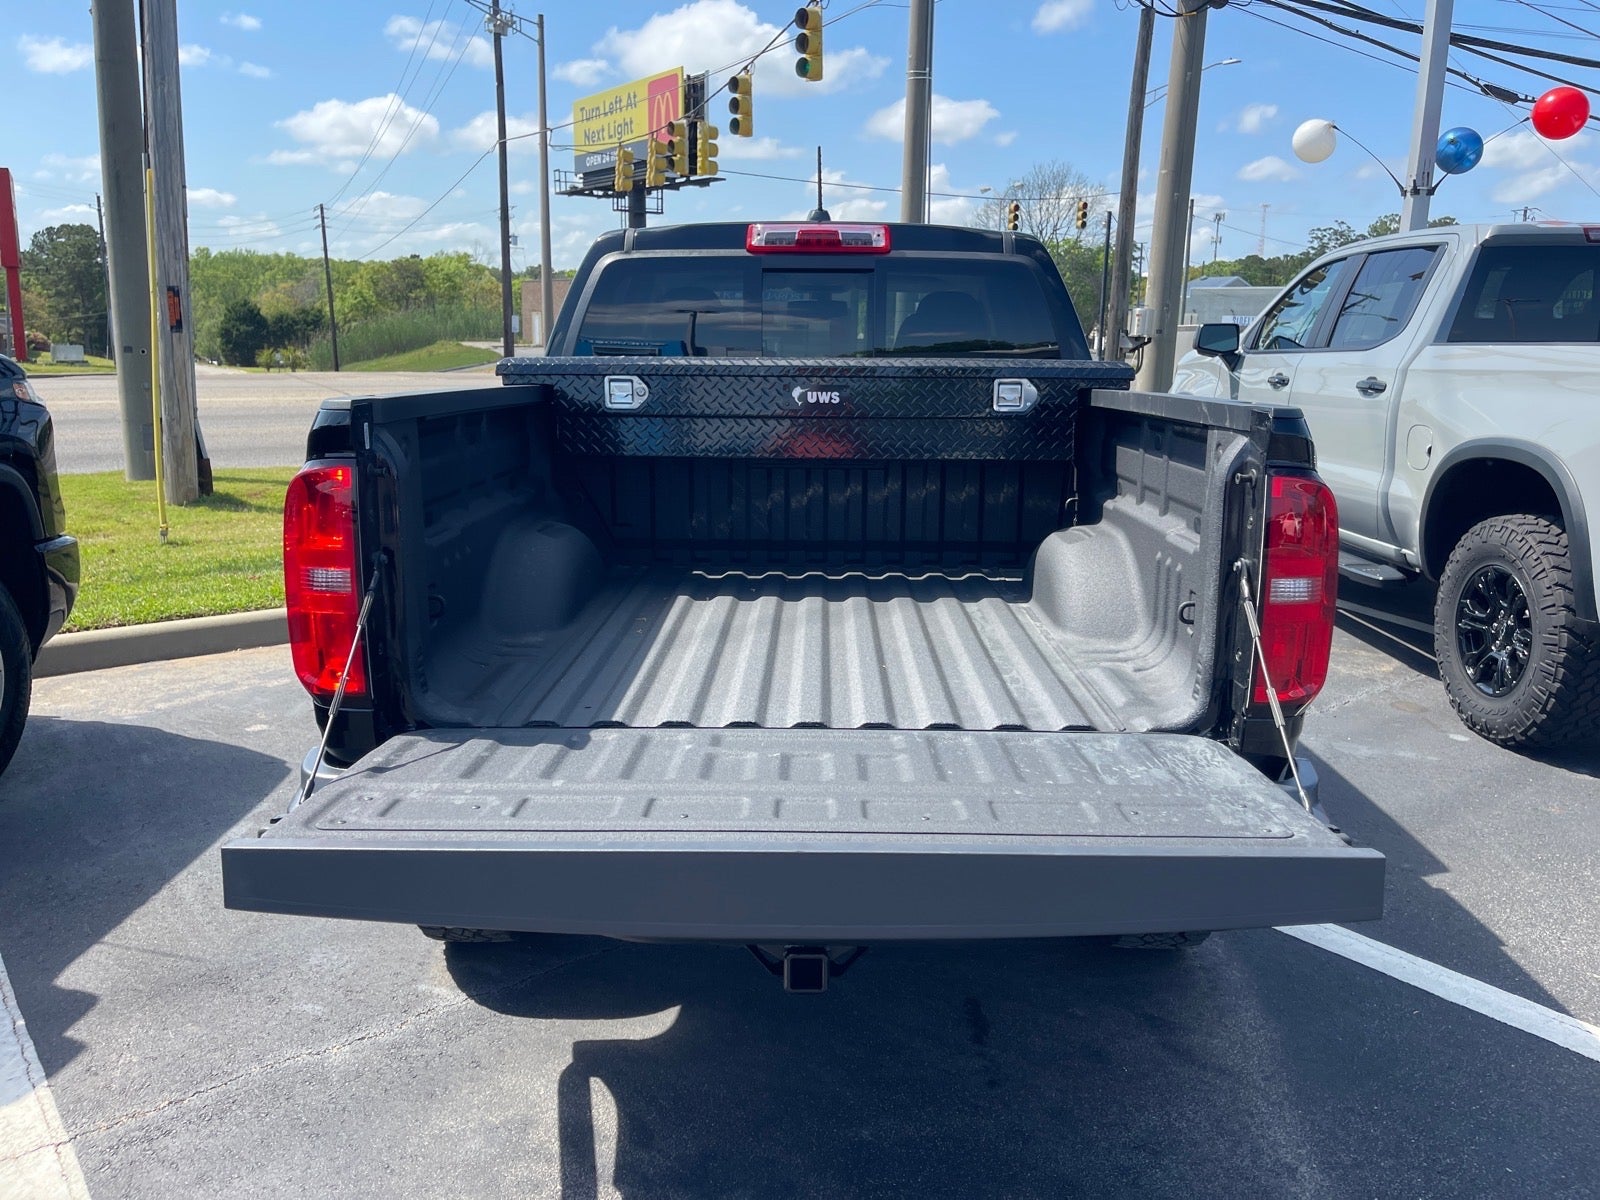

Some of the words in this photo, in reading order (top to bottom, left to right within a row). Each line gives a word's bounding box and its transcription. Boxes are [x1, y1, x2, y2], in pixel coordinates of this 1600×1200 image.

[580, 106, 601, 123] Turn
[603, 95, 622, 116] Left
[626, 91, 637, 110] At
[584, 124, 605, 145] Next
[608, 117, 634, 141] Light
[586, 154, 602, 167] OPEN
[602, 152, 610, 163] 24
[807, 391, 840, 404] UWS
